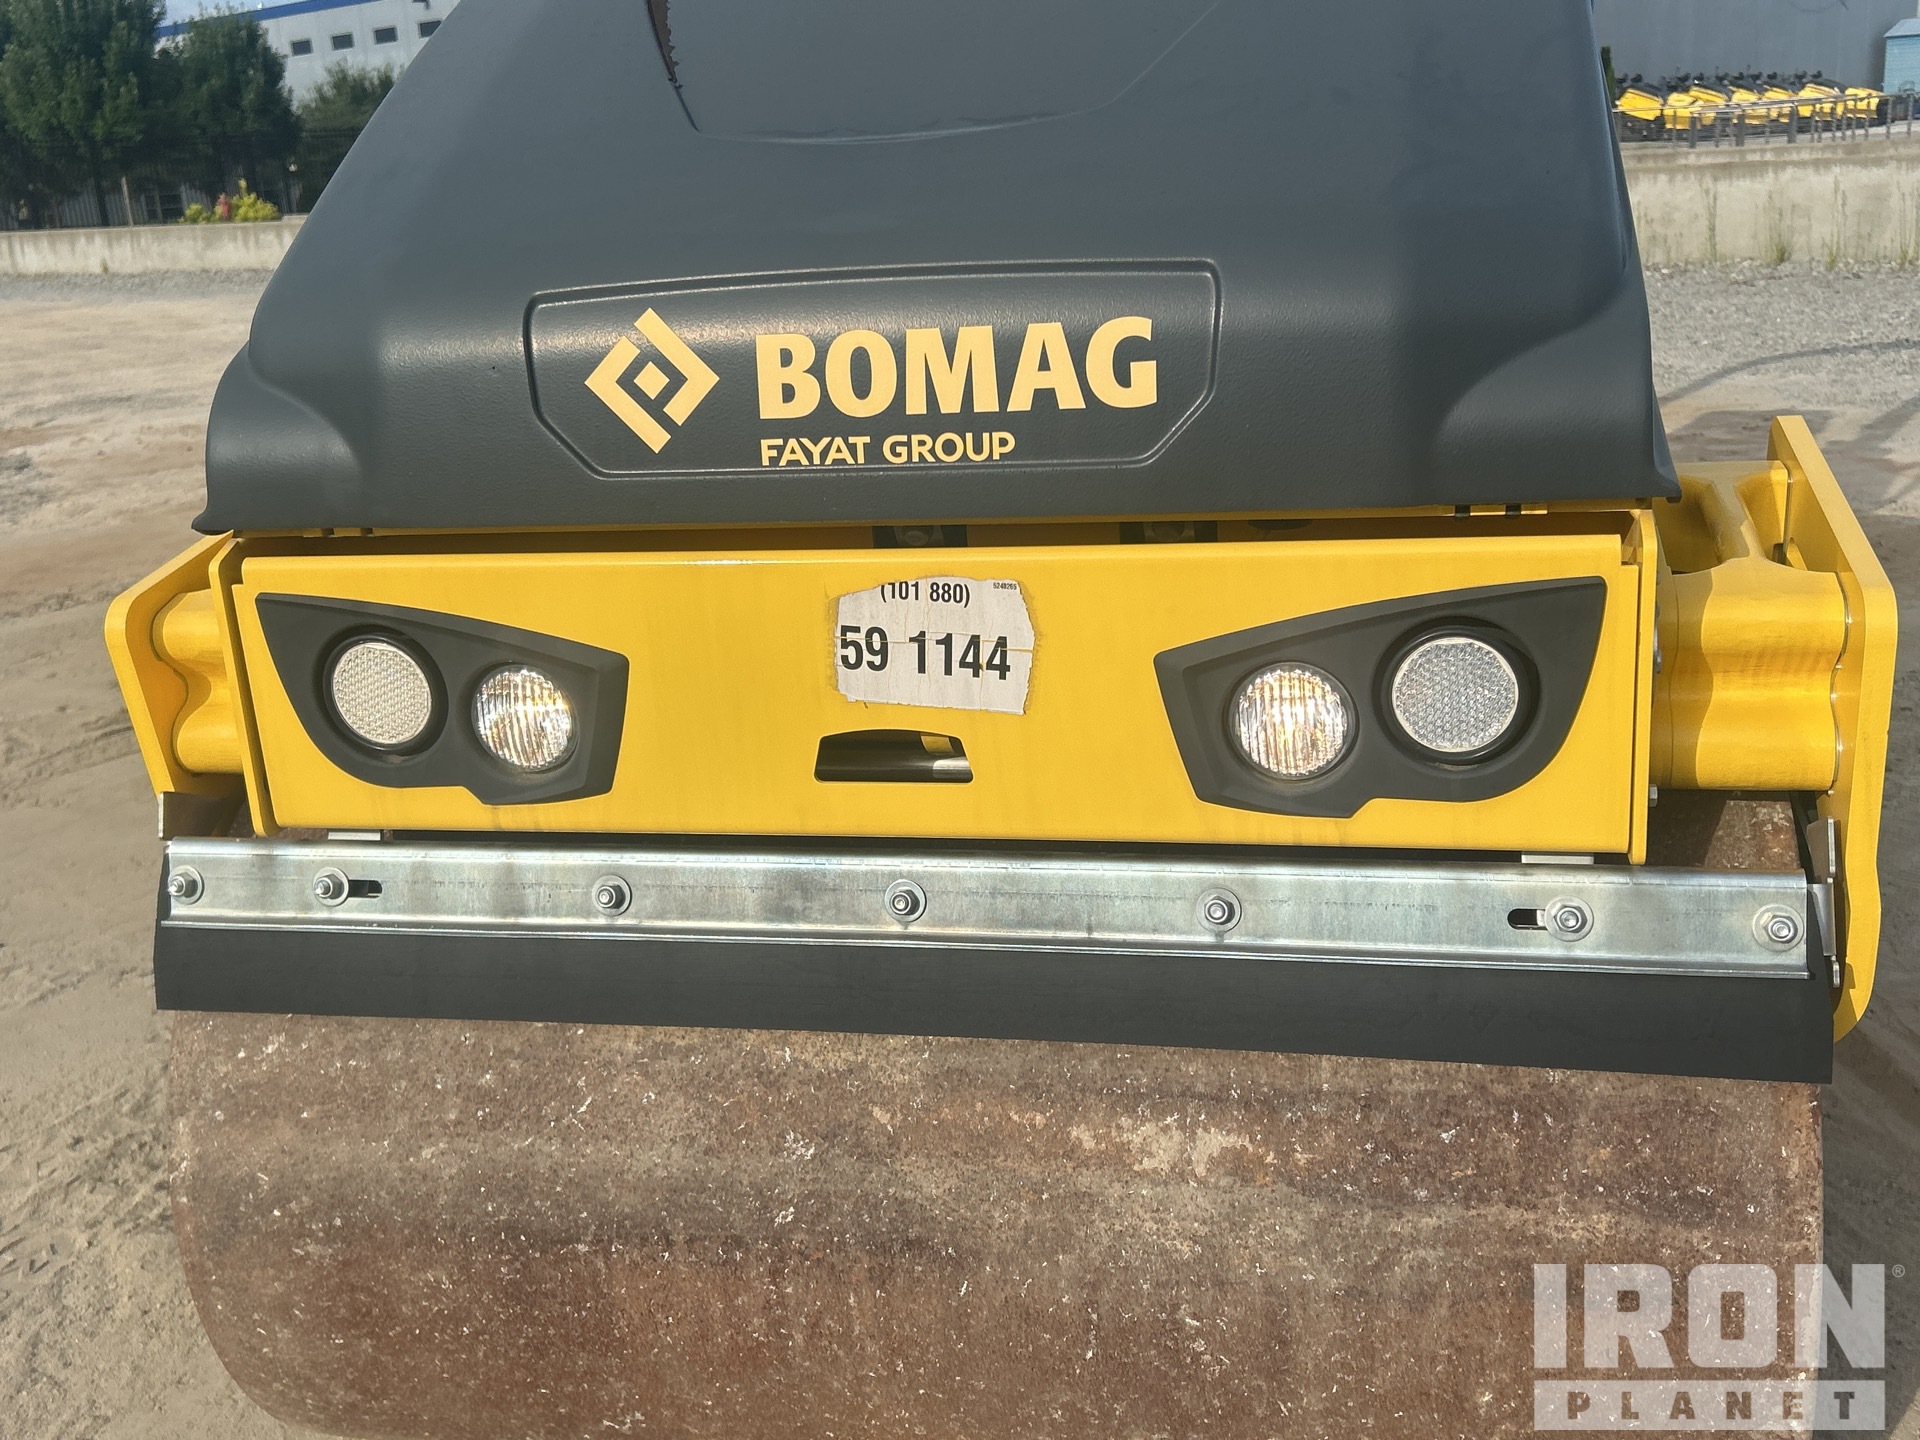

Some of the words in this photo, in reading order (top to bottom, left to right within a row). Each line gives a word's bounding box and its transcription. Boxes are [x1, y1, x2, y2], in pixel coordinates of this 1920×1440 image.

[756, 316, 1157, 420] BOMAG
[761, 435, 870, 466] FAYAT
[882, 431, 1016, 464] GROUP
[929, 582, 970, 608] 880)
[840, 625, 889, 671] 59
[909, 630, 1010, 680] 1144
